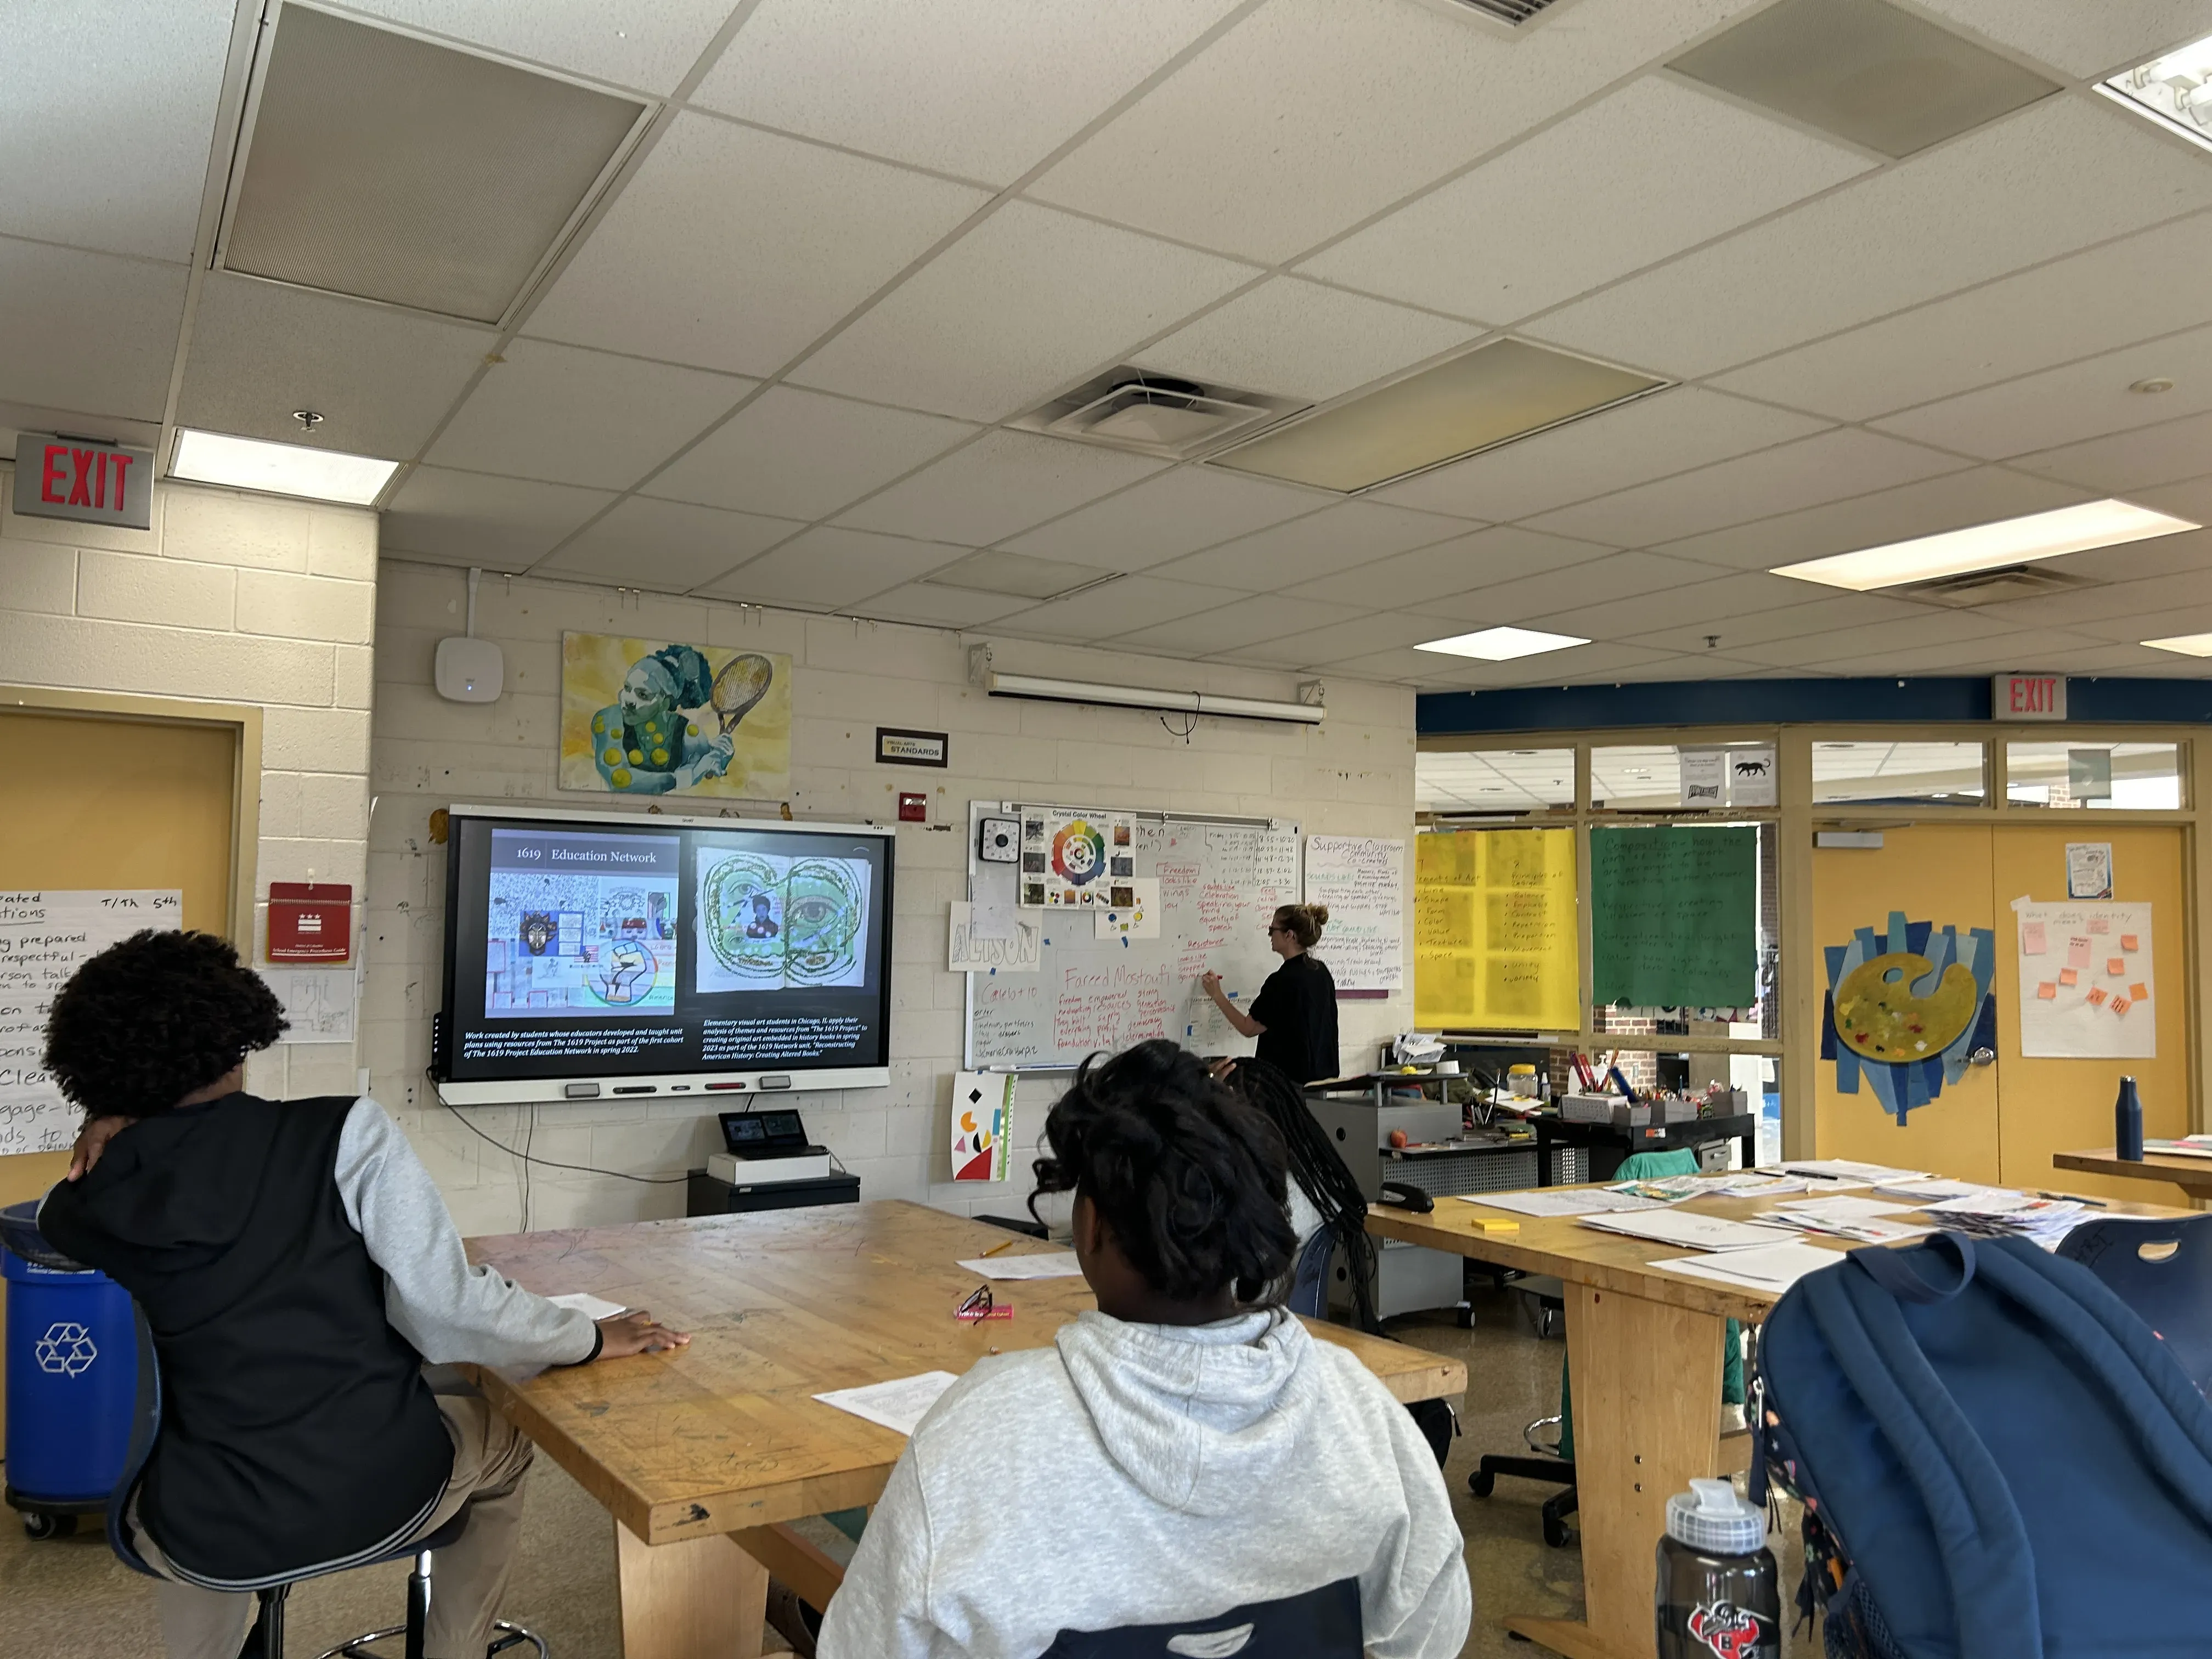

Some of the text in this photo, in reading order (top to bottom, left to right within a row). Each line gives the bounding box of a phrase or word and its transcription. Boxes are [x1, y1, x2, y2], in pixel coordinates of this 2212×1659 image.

[42, 444, 133, 512] EXIT
[2010, 678, 2056, 712] EXIT
[890, 746, 940, 756] STANDARDS
[1052, 809, 1071, 817] Crystal
[1089, 812, 1107, 820] Wheel
[1311, 836, 1404, 854] Supportive Classroom
[517, 847, 657, 864] 1619 Education Network
[1164, 863, 1197, 874] Freedom
[153, 896, 177, 909] 5th
[1423, 895, 1449, 905] Shape
[1164, 902, 1178, 913] joy
[1424, 917, 1444, 926] Color
[1427, 927, 1451, 935] Value
[20, 932, 86, 950] prepared
[1426, 938, 1463, 946] Texture
[1429, 950, 1453, 961] Space
[1511, 962, 1540, 974] Unity
[22, 979, 37, 989] to
[1064, 966, 1109, 990] Fareed
[981, 982, 1017, 1005] Caleb
[0, 1006, 22, 1015] on
[703, 1019, 738, 1028] Elementary
[738, 1018, 757, 1026] visual
[798, 1017, 821, 1025] Chicago,
[828, 1016, 845, 1025] apply
[844, 1016, 859, 1024] their
[484, 1031, 510, 1039] created
[511, 1030, 520, 1040] by
[520, 1030, 549, 1039] students
[549, 1029, 570, 1038] whose
[570, 1029, 602, 1037] educators
[603, 1028, 635, 1037] developed
[635, 1028, 648, 1036] and
[648, 1028, 669, 1037] taught
[670, 1027, 684, 1036] unit
[703, 1028, 727, 1036] analysis
[727, 1027, 735, 1036] of
[756, 1026, 769, 1034] and
[768, 1025, 796, 1034] resources
[795, 1025, 810, 1035] from
[824, 1024, 839, 1032] 1619
[464, 1041, 484, 1051] plans
[484, 1040, 504, 1049] using
[503, 1040, 536, 1048] resources
[535, 1039, 552, 1048] from
[553, 1039, 567, 1047] The
[567, 1038, 584, 1046] 1619
[584, 1037, 608, 1047] Project
[615, 1037, 630, 1047] part
[630, 1037, 639, 1046] of
[638, 1036, 650, 1045] the
[648, 1036, 663, 1046] first
[702, 1036, 728, 1045] creating
[728, 1035, 753, 1043] original
[762, 1034, 792, 1042] embedded
[798, 1033, 819, 1042] history
[819, 1032, 836, 1041] books
[842, 1032, 861, 1041] spring
[464, 1046, 640, 1059] of The 1619 Project Education Network in spring 2022.
[702, 1044, 719, 1052] 2023
[726, 1044, 740, 1052] part
[740, 1043, 748, 1052] of
[758, 1042, 773, 1051] 1619
[773, 1042, 799, 1050] Network
[702, 1052, 731, 1060] American
[755, 1051, 781, 1059] Creating
[38, 1127, 62, 1144] to
